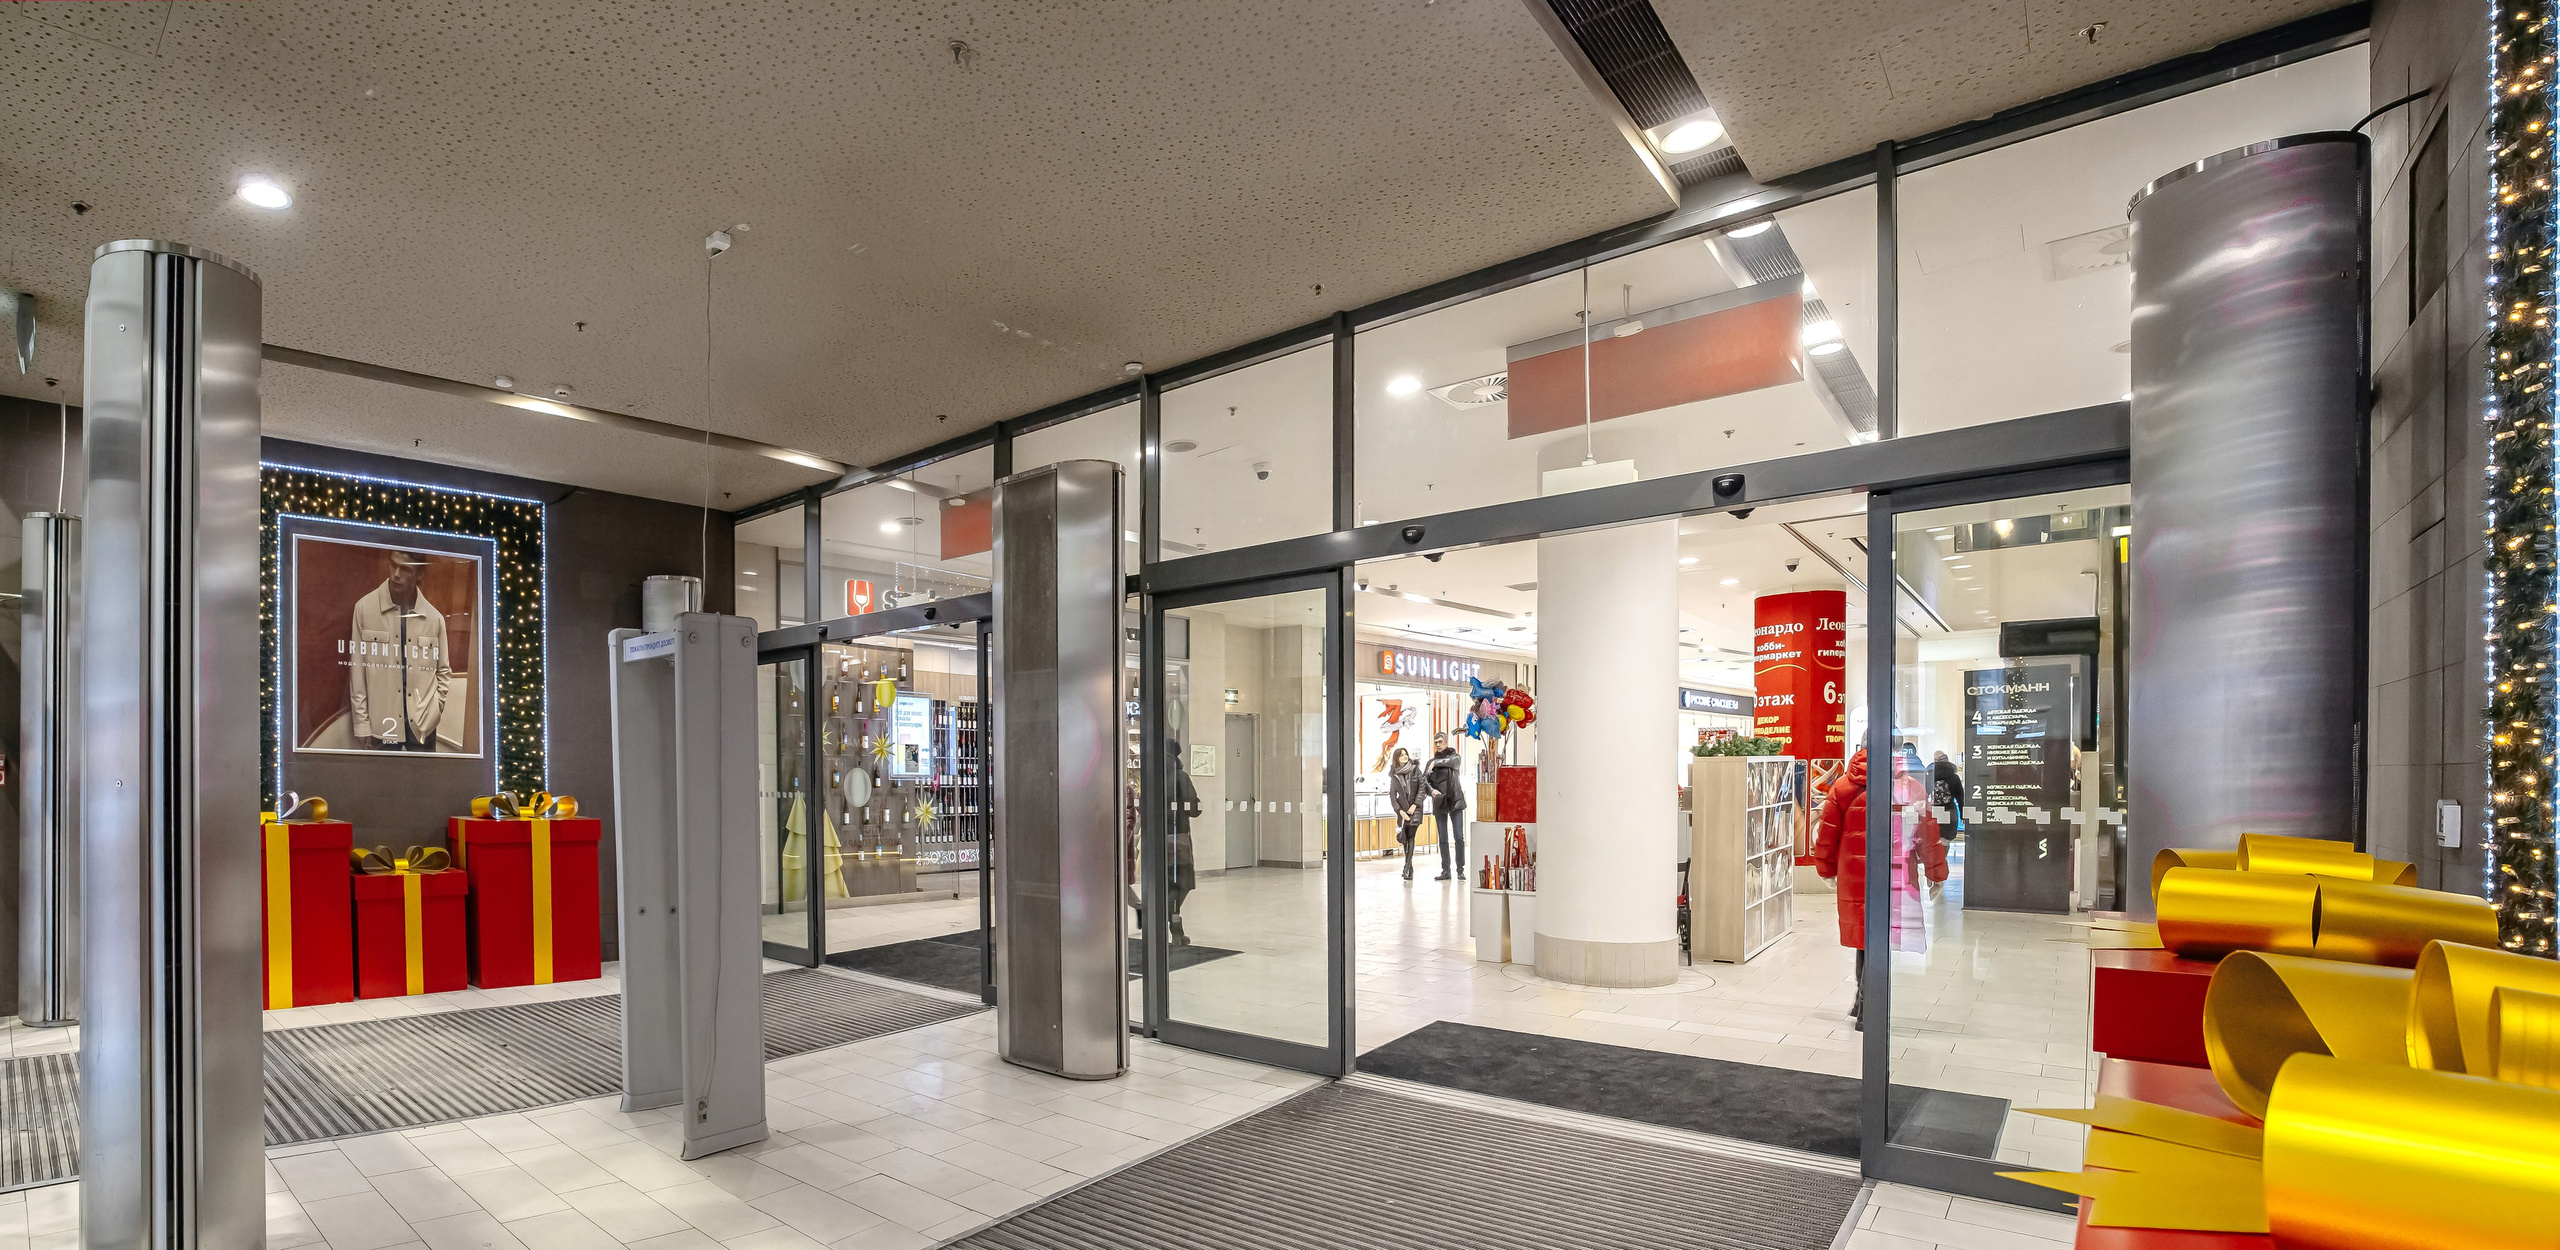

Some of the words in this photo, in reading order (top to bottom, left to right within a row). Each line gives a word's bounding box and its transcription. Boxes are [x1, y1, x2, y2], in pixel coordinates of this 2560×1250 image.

[337, 639, 440, 660] URBANTIGER
[1395, 653, 1480, 682] SUNLIGHT
[1823, 681, 1836, 704] 6
[1966, 682, 2050, 695] СТОКМАНН
[1972, 710, 1982, 721] 4
[382, 717, 399, 737] 2
[1972, 745, 1982, 756] 3
[1972, 785, 1982, 796] 2
